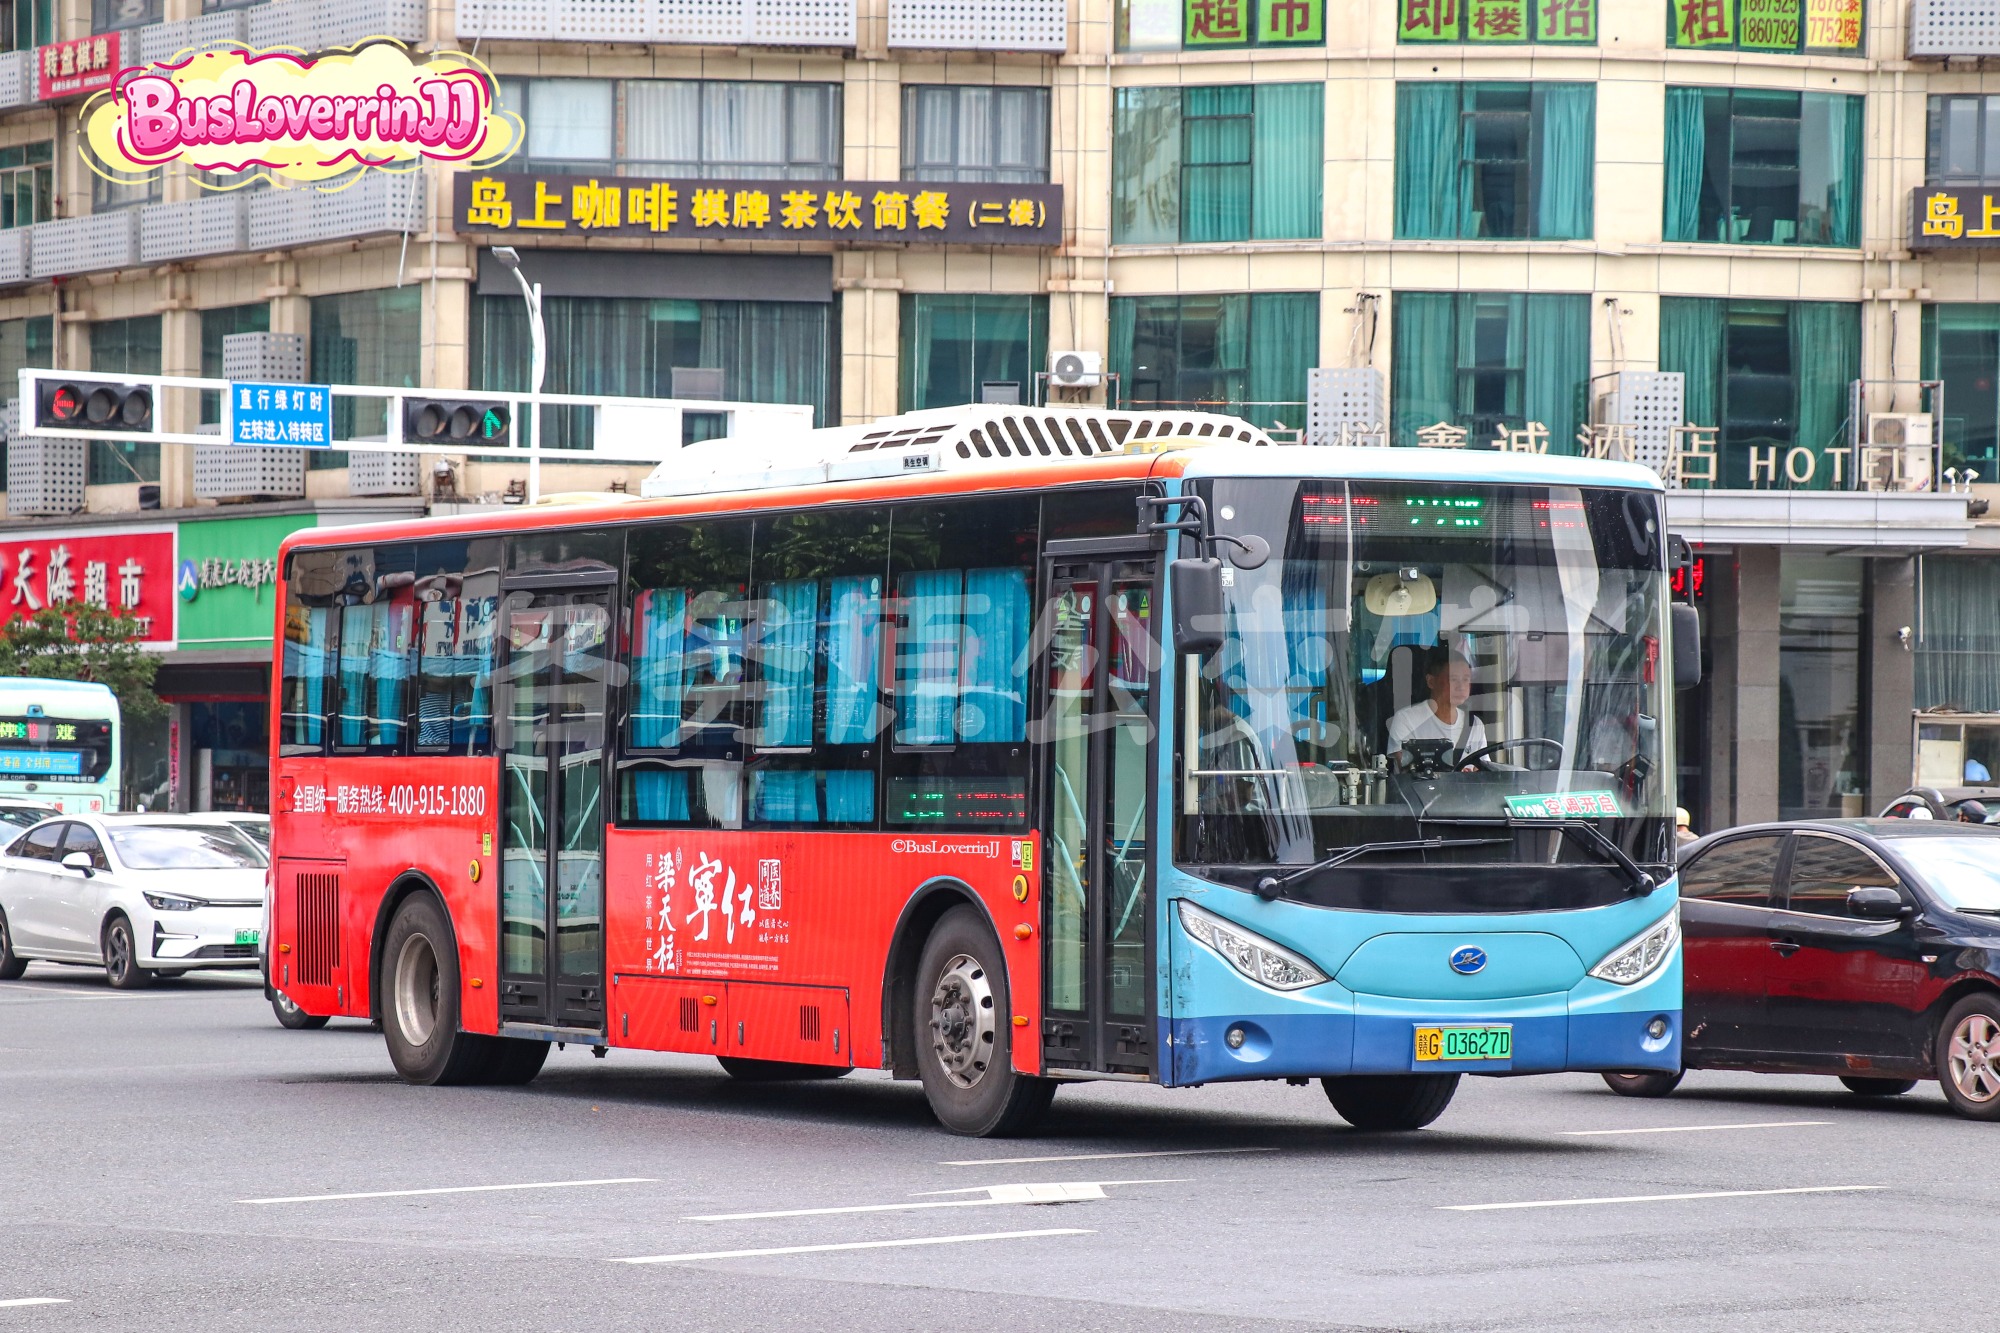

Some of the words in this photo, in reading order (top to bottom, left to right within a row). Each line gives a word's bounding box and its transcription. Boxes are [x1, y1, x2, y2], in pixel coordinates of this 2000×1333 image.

[467, 176, 678, 232] 岛上咖啡
[240, 388, 323, 412] 直行绿灯时
[239, 419, 324, 442] 左转进入待转区
[1749, 446, 1913, 484] HOTEL
